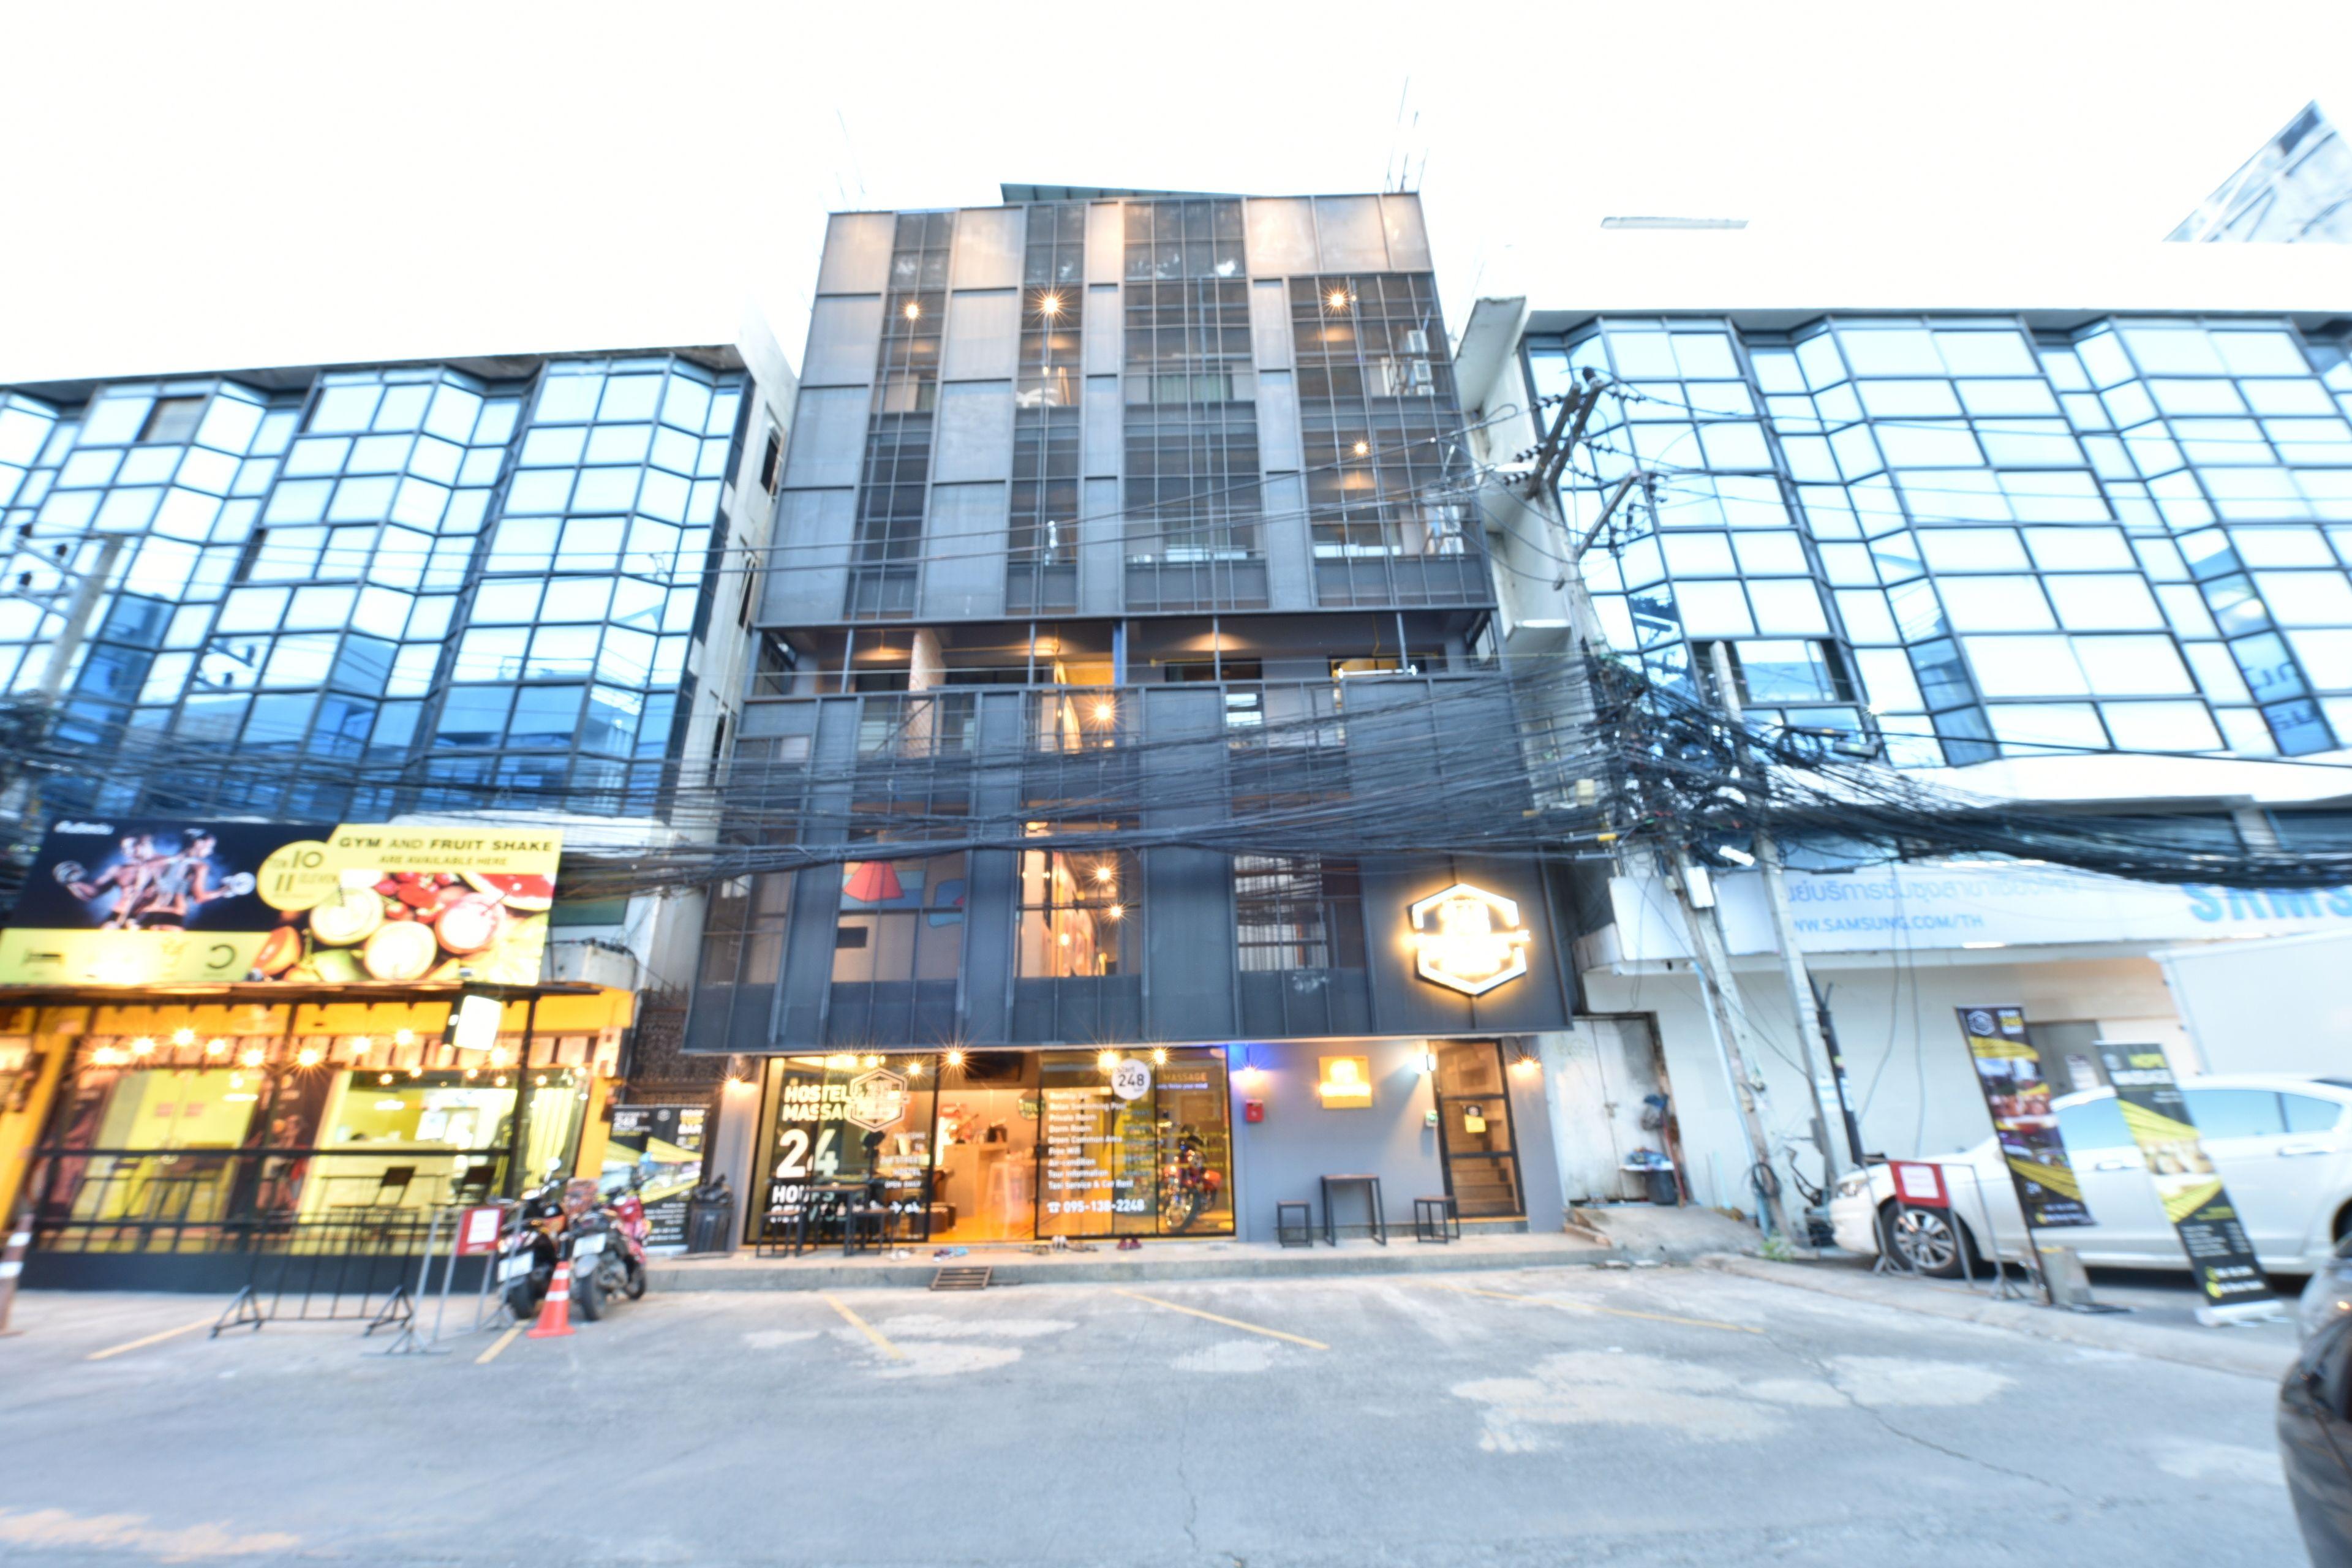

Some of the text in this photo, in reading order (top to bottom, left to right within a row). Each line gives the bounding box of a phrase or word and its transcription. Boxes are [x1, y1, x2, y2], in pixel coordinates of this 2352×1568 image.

[339, 837, 552, 852] GYM AND FRUIT SHAKE
[1118, 1073, 1145, 1087] 248
[784, 1085, 850, 1103] HOSTEL
[775, 1128, 839, 1178] 24
